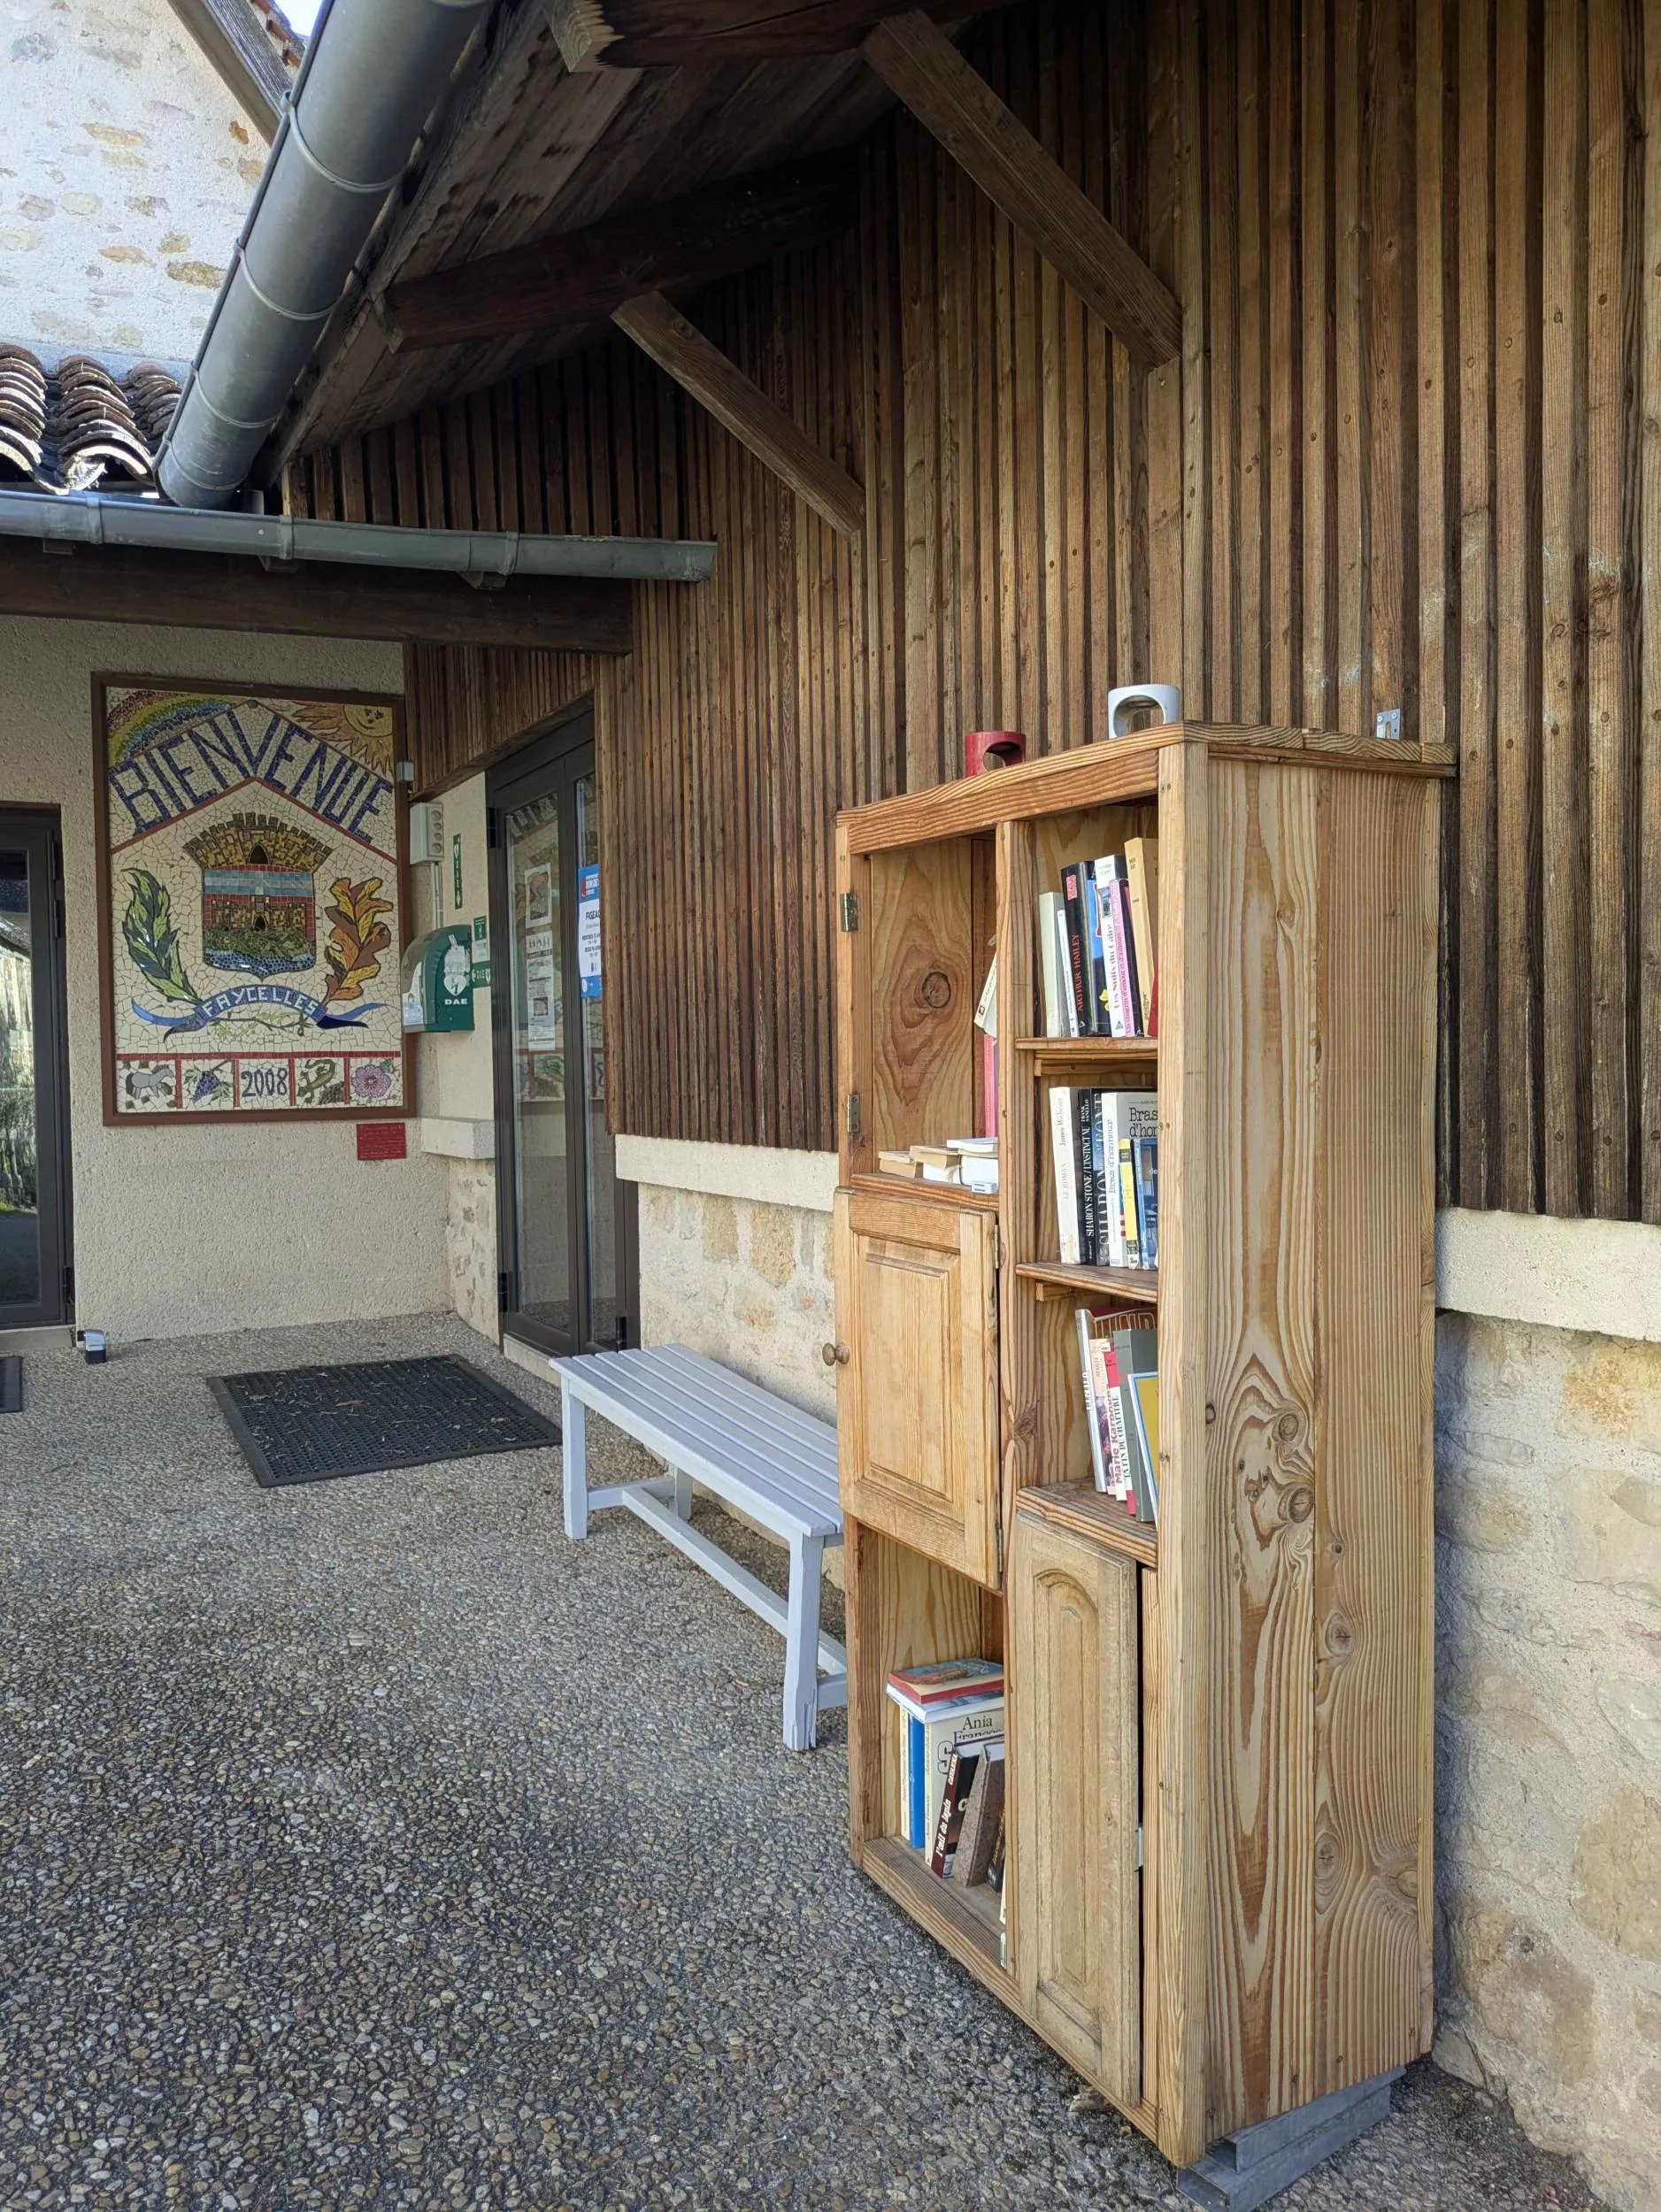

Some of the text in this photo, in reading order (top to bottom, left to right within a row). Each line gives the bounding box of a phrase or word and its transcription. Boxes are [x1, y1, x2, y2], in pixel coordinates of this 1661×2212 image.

[110, 709, 394, 843] BIENVENUE
[1072, 934, 1084, 1012] ARTHUR HAILEY
[203, 985, 317, 1016] FAYCELLES
[241, 1065, 288, 1096] 2008
[1128, 1107, 1158, 1121] Bras
[1084, 1175, 1094, 1202] STONE
[1085, 1202, 1095, 1237] SHARON
[1112, 1448, 1123, 1484] Marie
[962, 1717, 993, 1731] Ania
[943, 1798, 952, 1819] lapin
